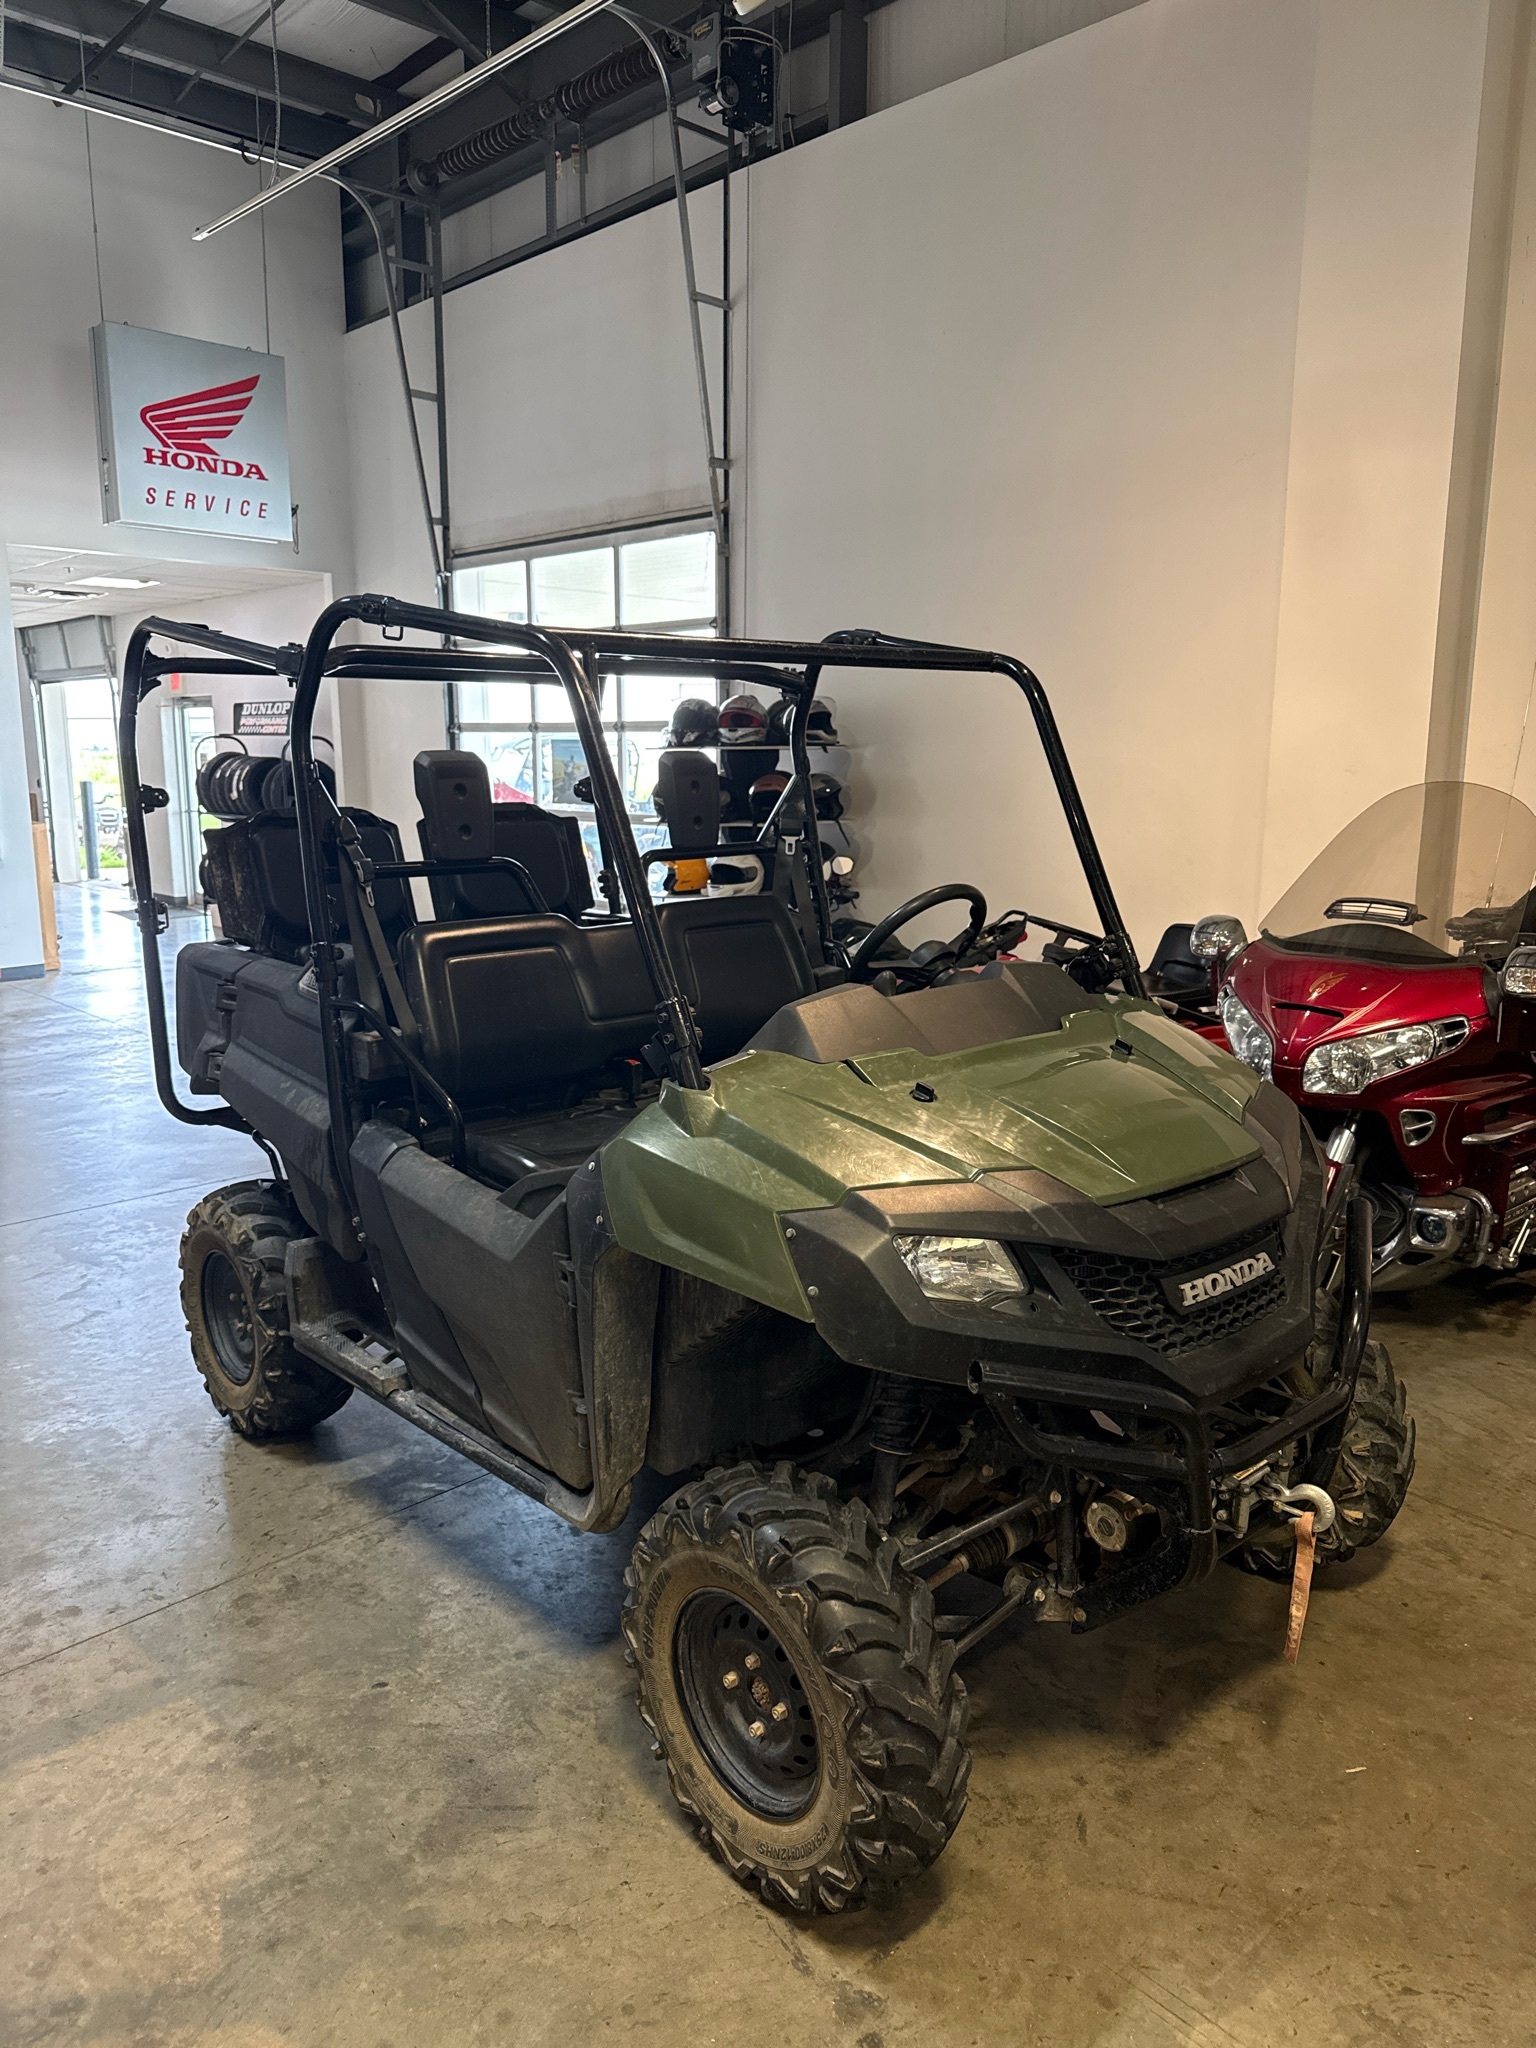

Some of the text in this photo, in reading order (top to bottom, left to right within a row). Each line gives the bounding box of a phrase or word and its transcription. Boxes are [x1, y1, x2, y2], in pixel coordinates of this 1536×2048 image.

[143, 447, 269, 481] HONDA
[145, 487, 268, 519] SERVICE
[241, 702, 291, 715] DUNLOP
[1178, 1251, 1275, 1307] HONDA
